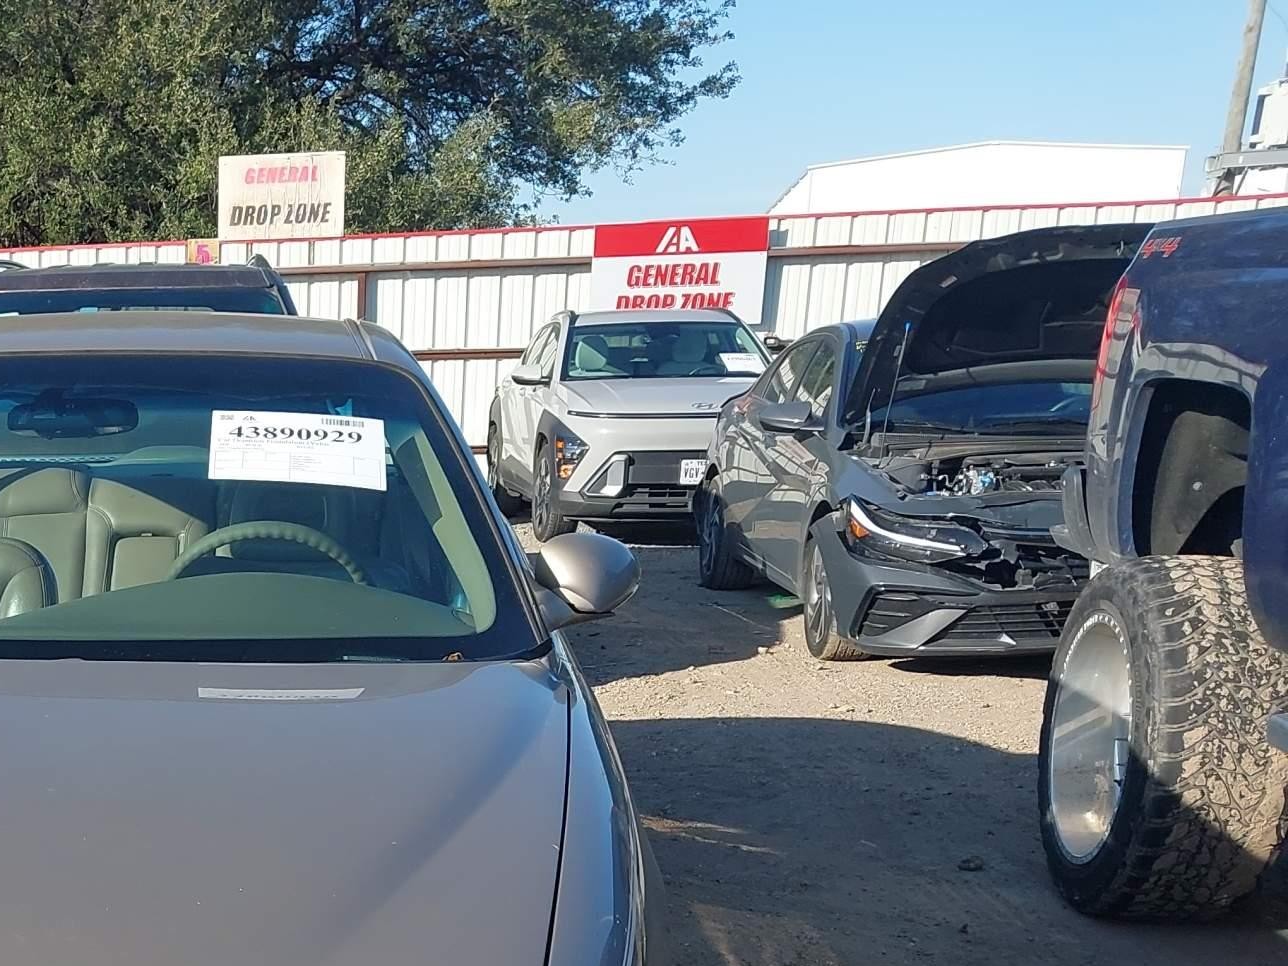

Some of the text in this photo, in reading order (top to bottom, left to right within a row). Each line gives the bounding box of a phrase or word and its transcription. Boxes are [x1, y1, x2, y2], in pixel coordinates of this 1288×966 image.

[244, 165, 318, 184] GENERAL
[230, 202, 332, 226] DROP ZONE
[627, 262, 721, 288] GENERAL
[229, 426, 362, 443] 43890929
